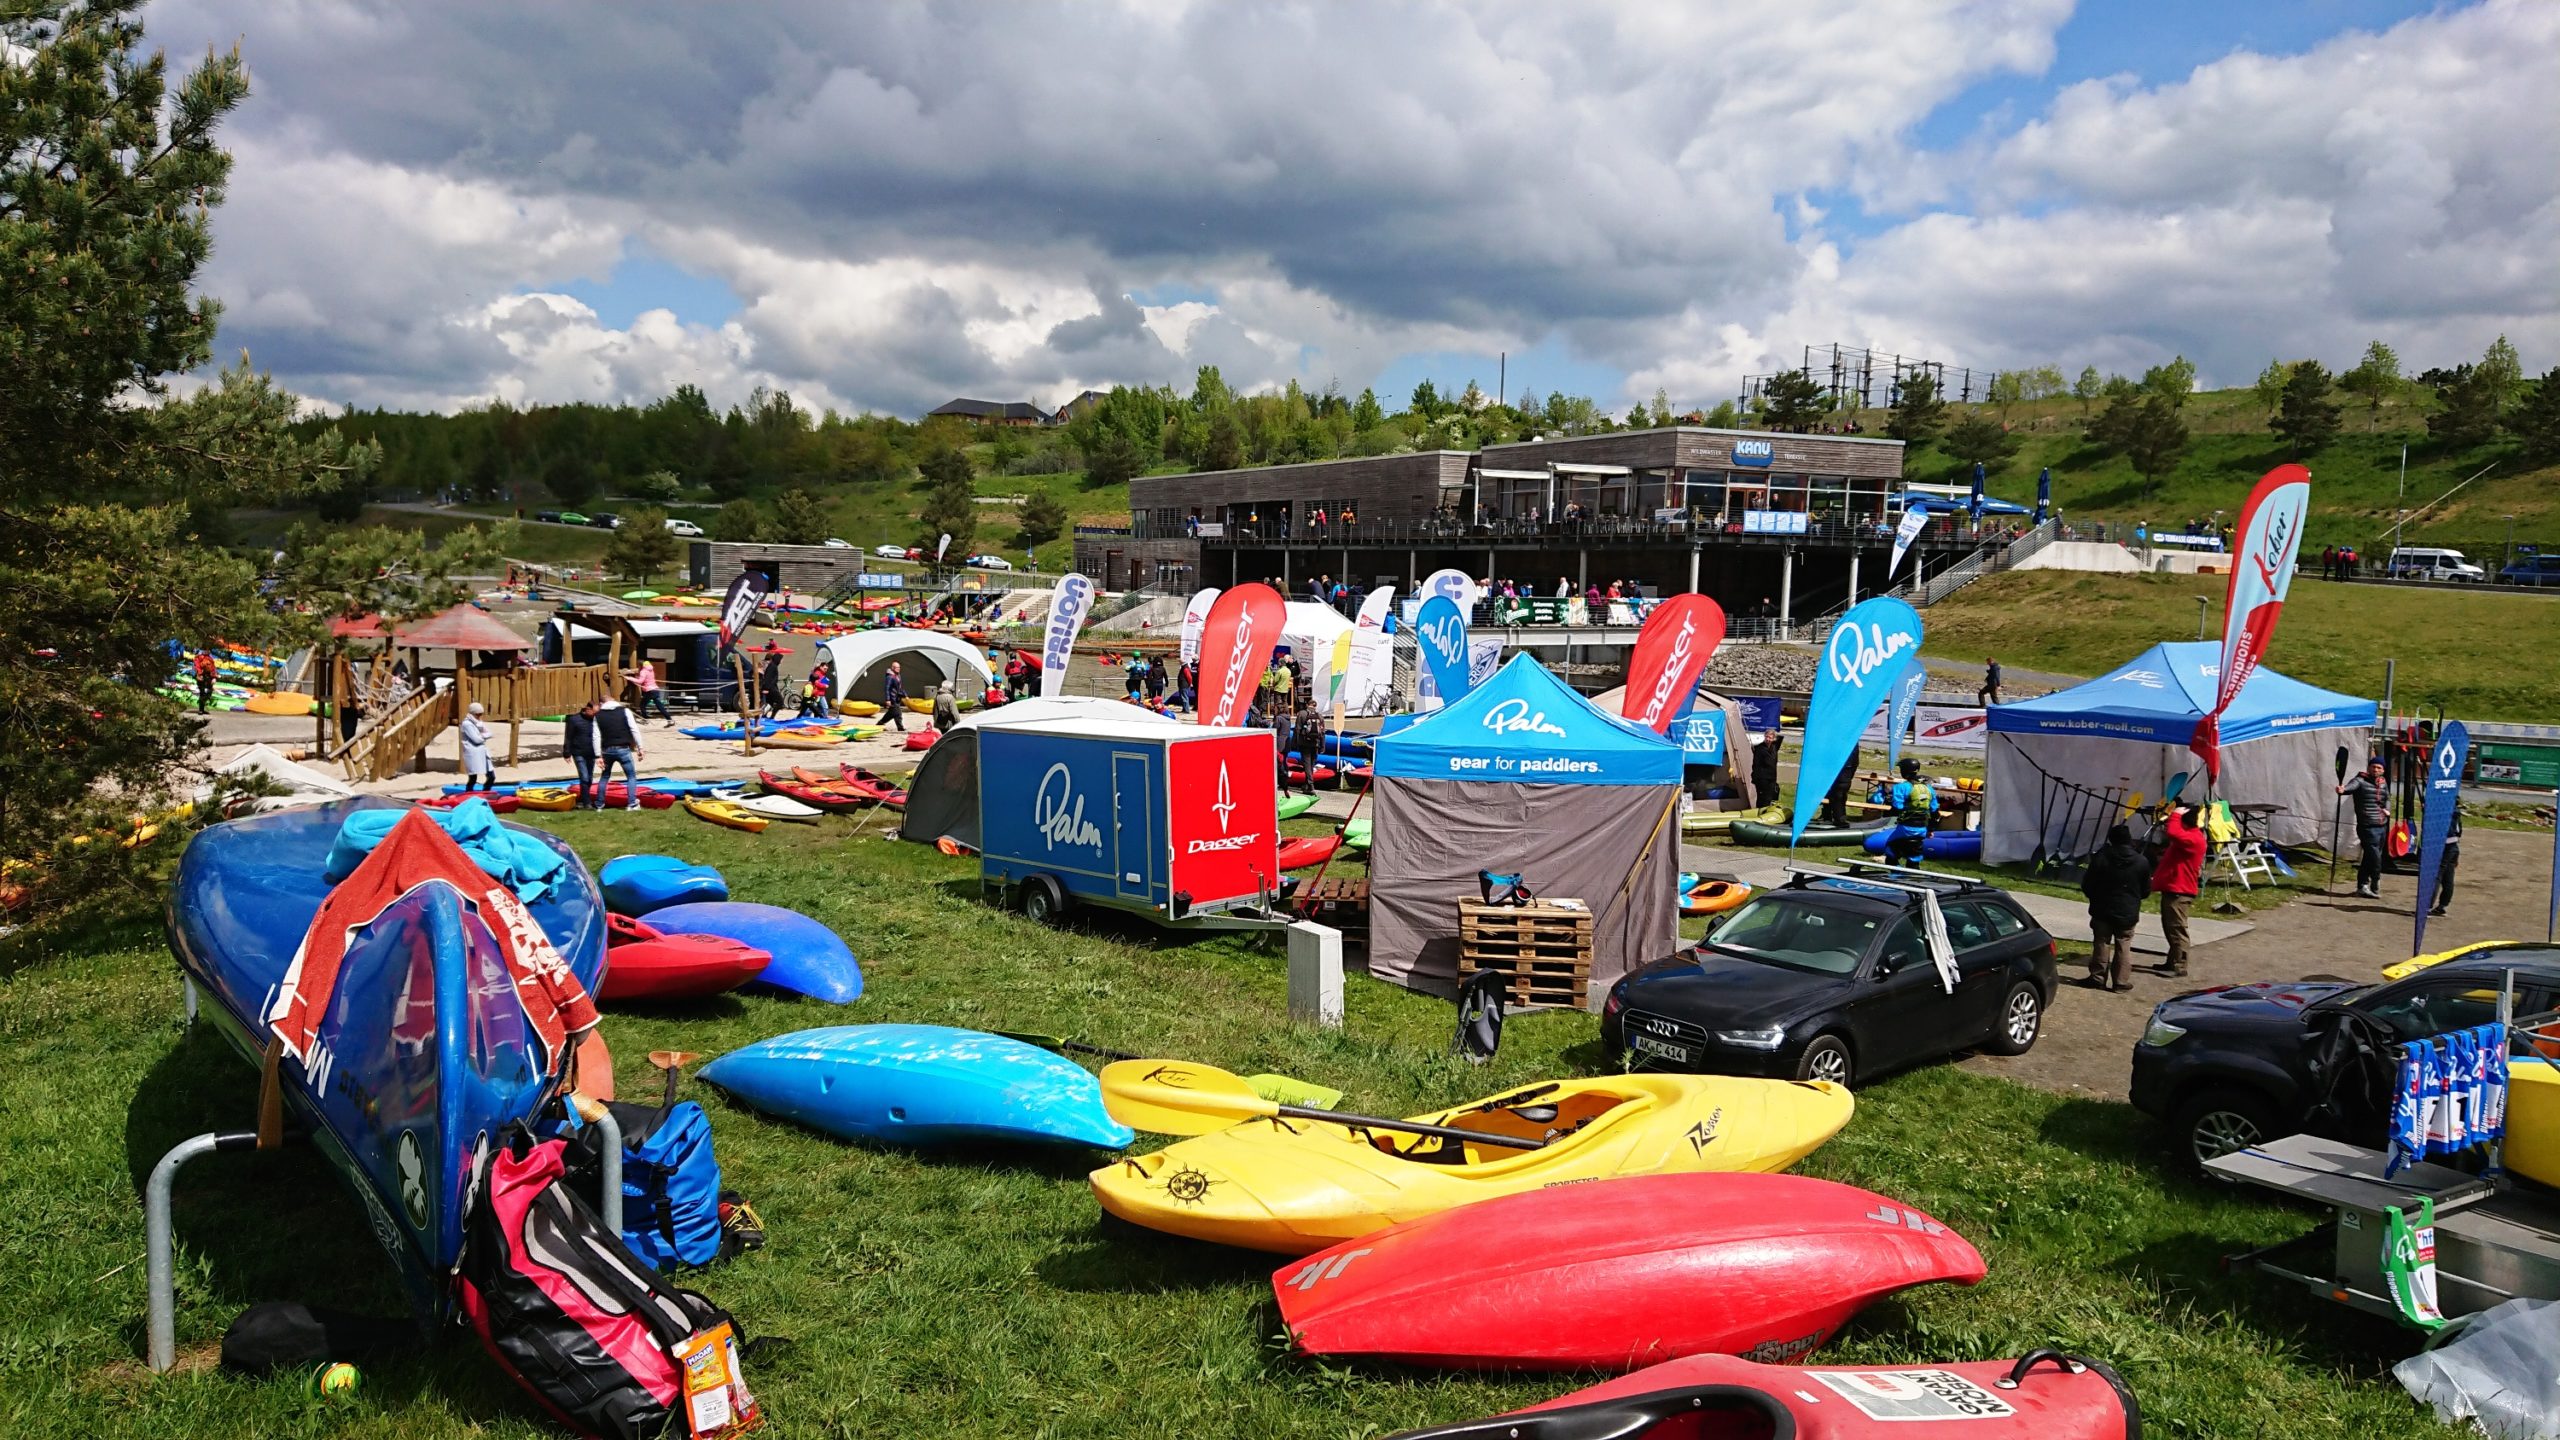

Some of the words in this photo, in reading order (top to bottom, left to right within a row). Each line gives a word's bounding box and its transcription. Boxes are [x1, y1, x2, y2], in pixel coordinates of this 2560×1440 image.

[1736, 440, 1771, 455] KANU
[1045, 578, 1087, 671] PRIJON
[1829, 622, 1914, 688] Palm
[1482, 698, 1566, 738] Palm
[1687, 721, 1711, 735] RIS
[1685, 737, 1717, 751] ART
[1450, 757, 1491, 771] gear
[1495, 757, 1516, 770] for
[2434, 779, 2457, 789] SPADE
[1035, 762, 1103, 852] Palm
[1187, 833, 1260, 854] Dagger
[1664, 1045, 1683, 1060] 414
[687, 1344, 714, 1366] MAOAM
[1900, 1372, 1983, 1416] GARANT
